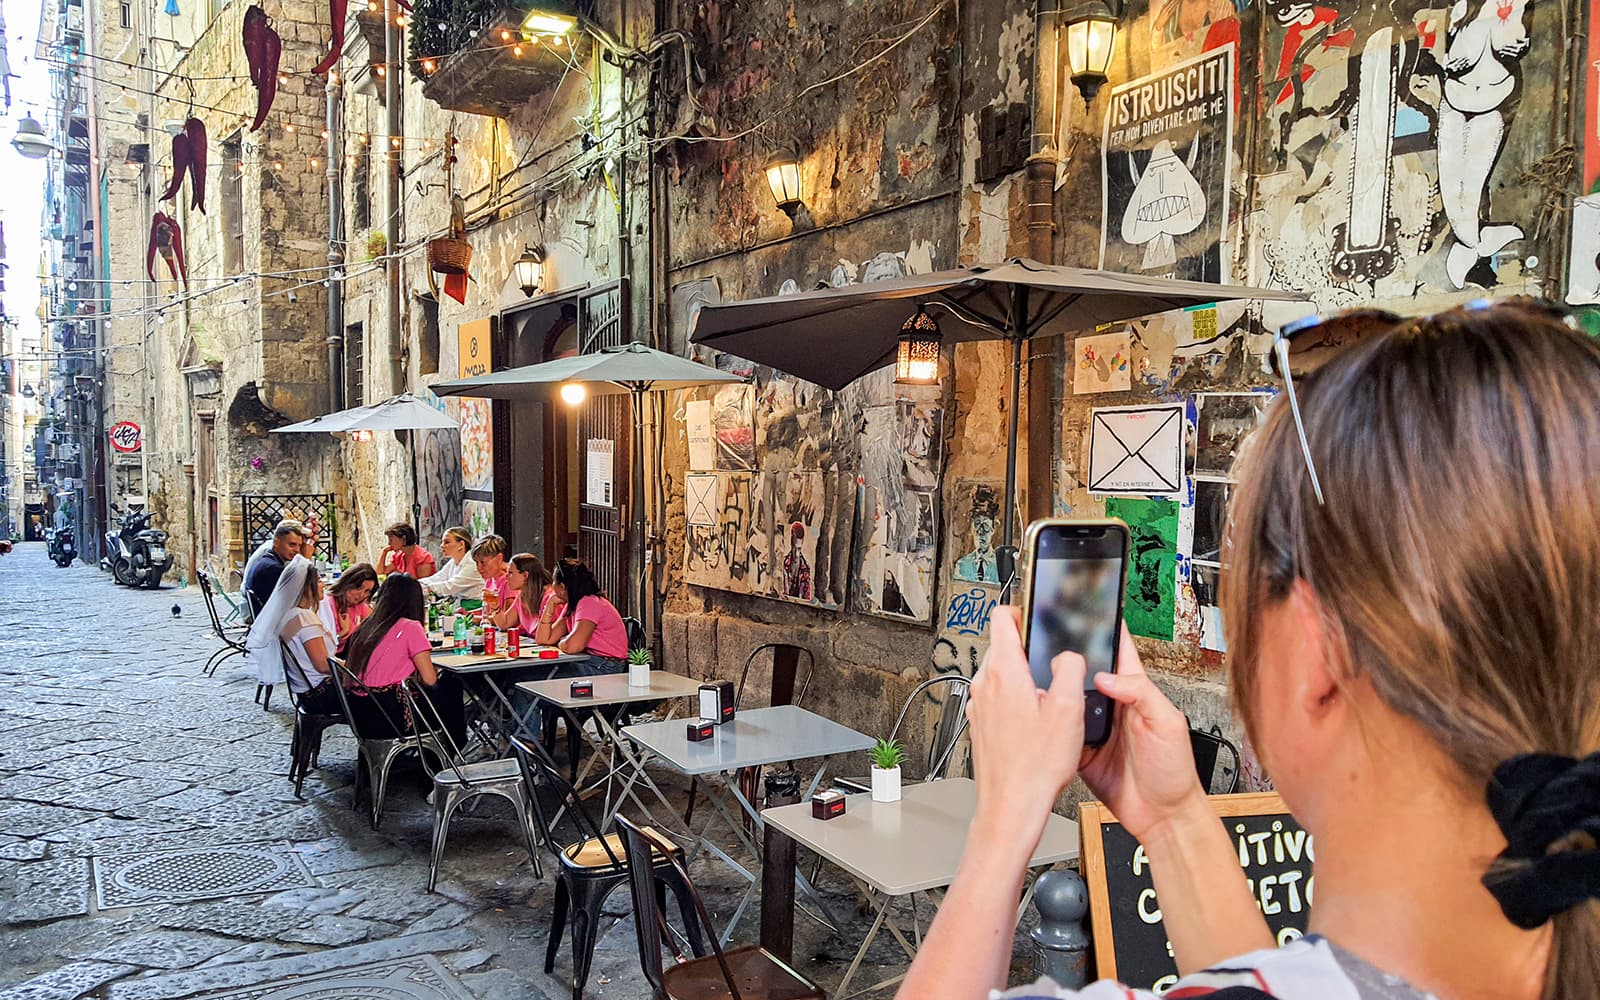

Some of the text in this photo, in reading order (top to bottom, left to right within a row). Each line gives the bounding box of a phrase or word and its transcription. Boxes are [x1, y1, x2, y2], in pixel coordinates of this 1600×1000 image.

[1109, 96, 1223, 147] PER NON DIVENTARE COME ME
[1111, 56, 1225, 128] ISTRUISCITI
